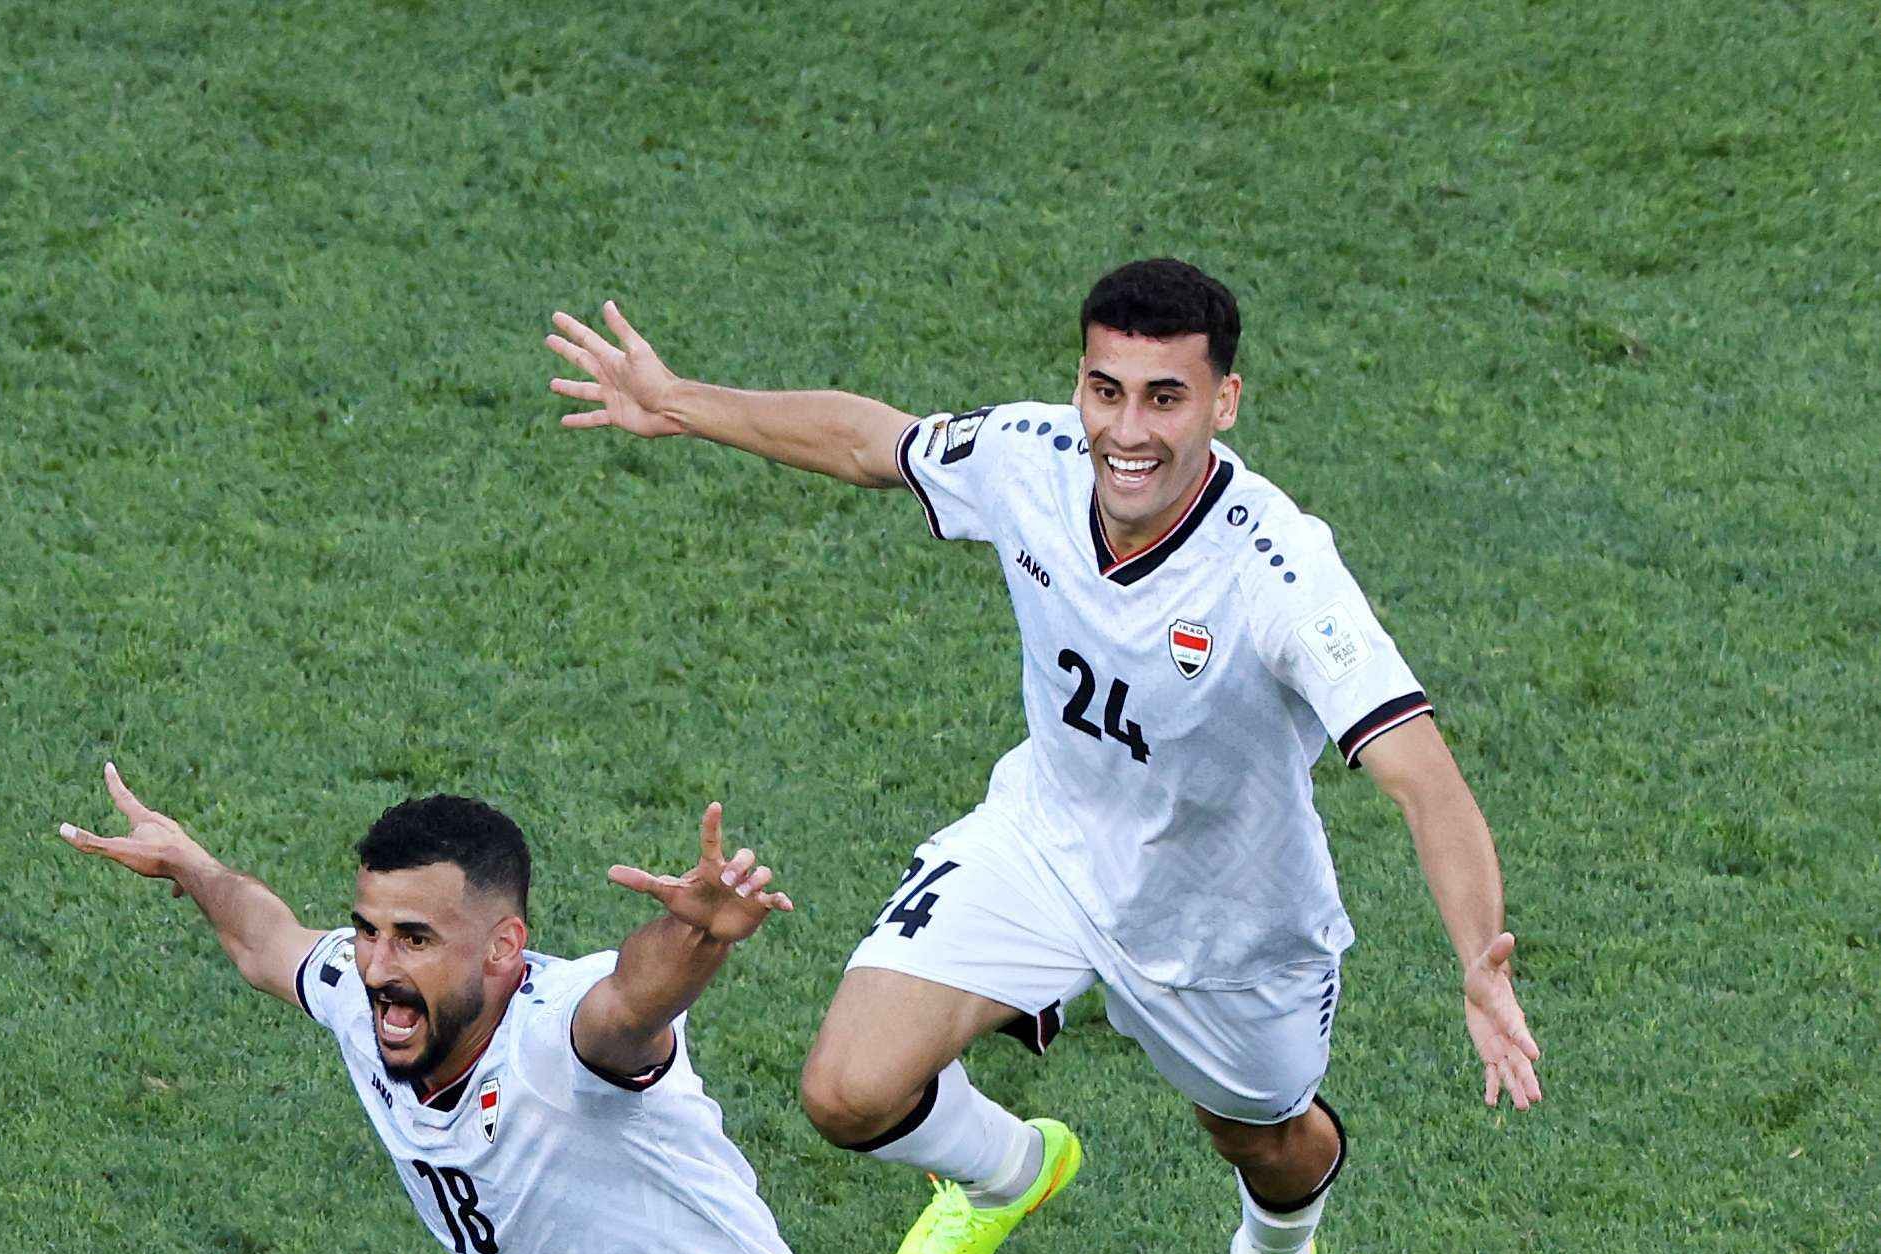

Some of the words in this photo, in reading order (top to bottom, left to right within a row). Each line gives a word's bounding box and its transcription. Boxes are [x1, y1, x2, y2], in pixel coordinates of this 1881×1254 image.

[1015, 549, 1050, 588] JAKO
[1058, 648, 1151, 764] 24
[371, 1071, 393, 1110] JAKO
